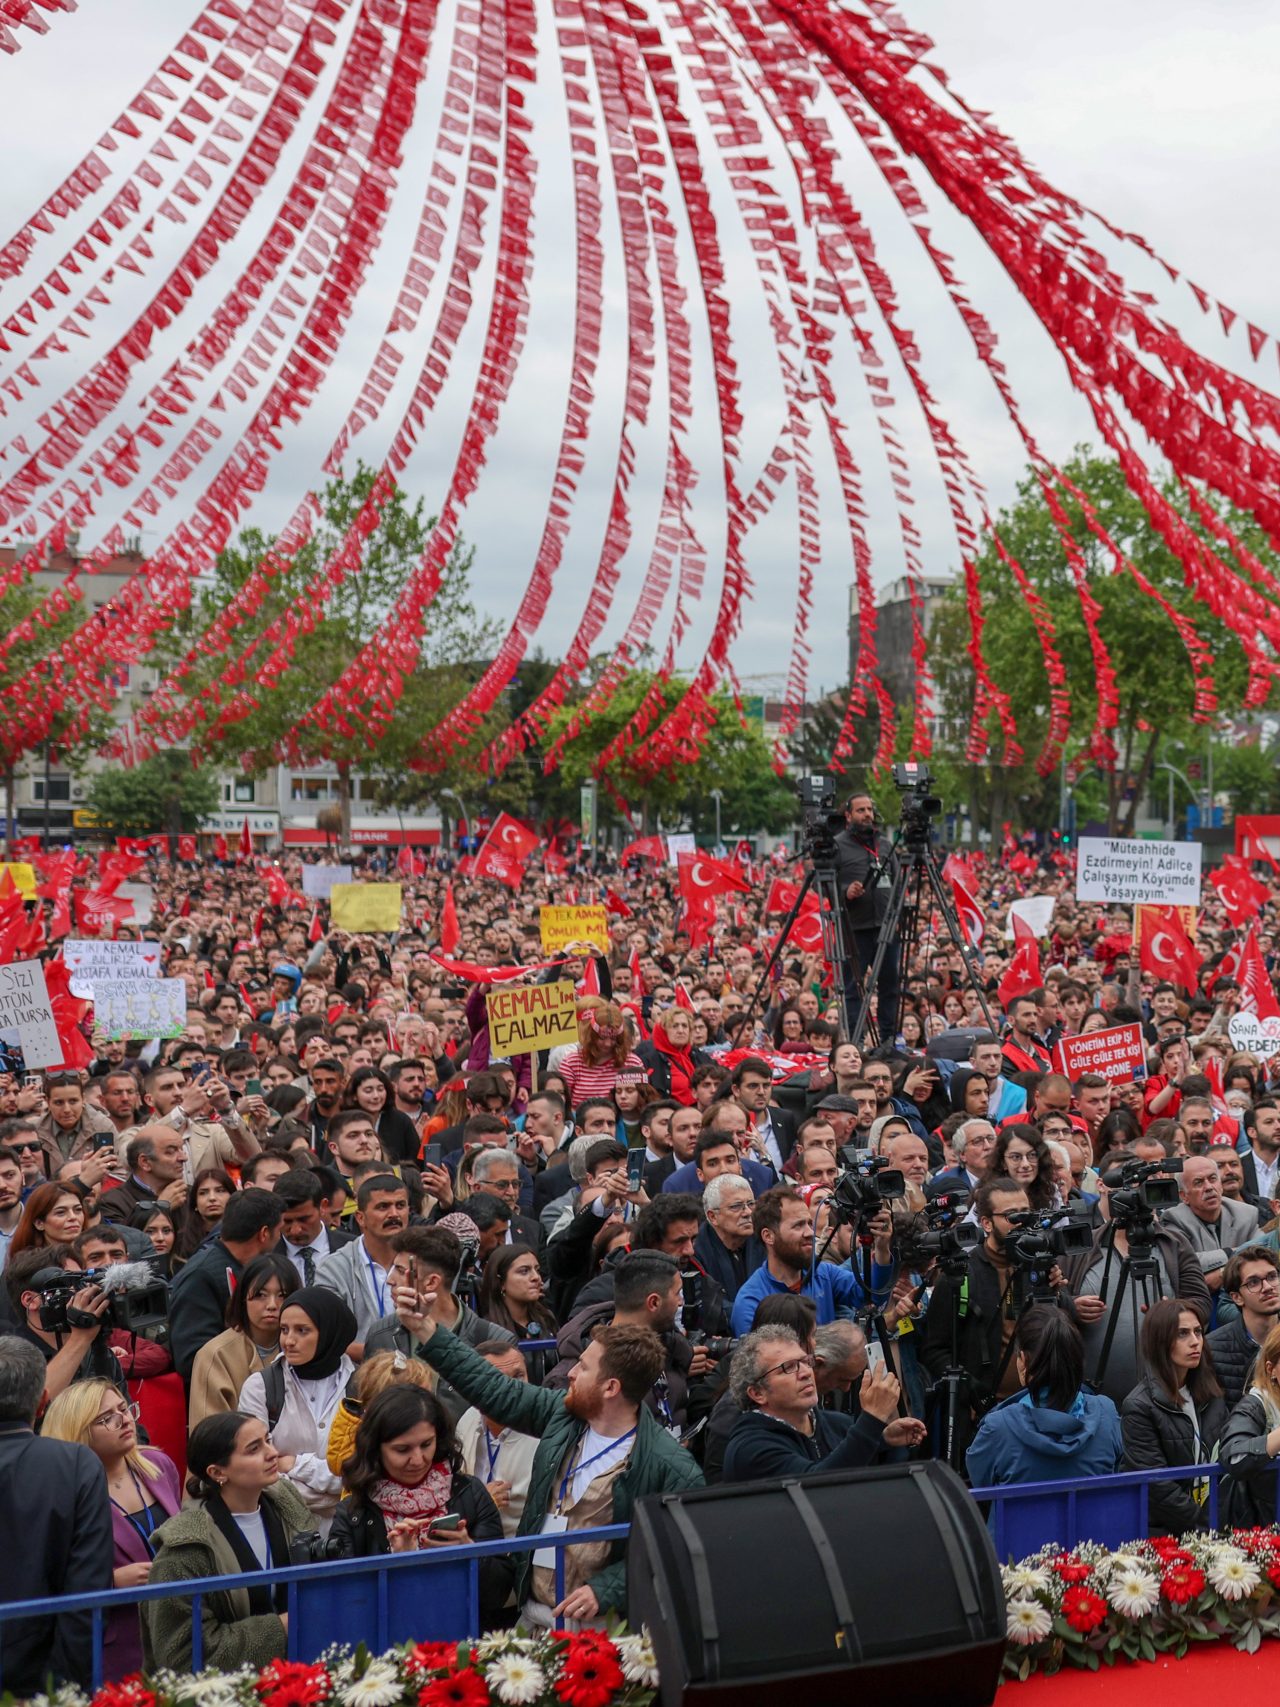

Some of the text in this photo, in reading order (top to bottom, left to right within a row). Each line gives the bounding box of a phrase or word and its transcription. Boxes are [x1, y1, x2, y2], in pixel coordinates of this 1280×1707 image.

[1104, 841, 1176, 856] "Müteahhide
[1086, 855, 1193, 871] Ezdirmeyin! Adilce
[1082, 870, 1196, 887] Çalışayım Köyümde
[1103, 885, 1175, 901] Yaşayayım."
[103, 942, 144, 955] KEMAL
[117, 966, 156, 979] KEMAL
[13, 1007, 51, 1026] DURSA
[494, 1010, 576, 1049] ÇALMAZ
[1230, 1018, 1258, 1035] SANA
[1068, 1037, 1106, 1055] YÖNETİM
[1106, 1032, 1123, 1047] EKİP
[1237, 1039, 1280, 1053] DEDEM
[1069, 1042, 1141, 1069] GÜLE GÜLE TEK KİŞİ
